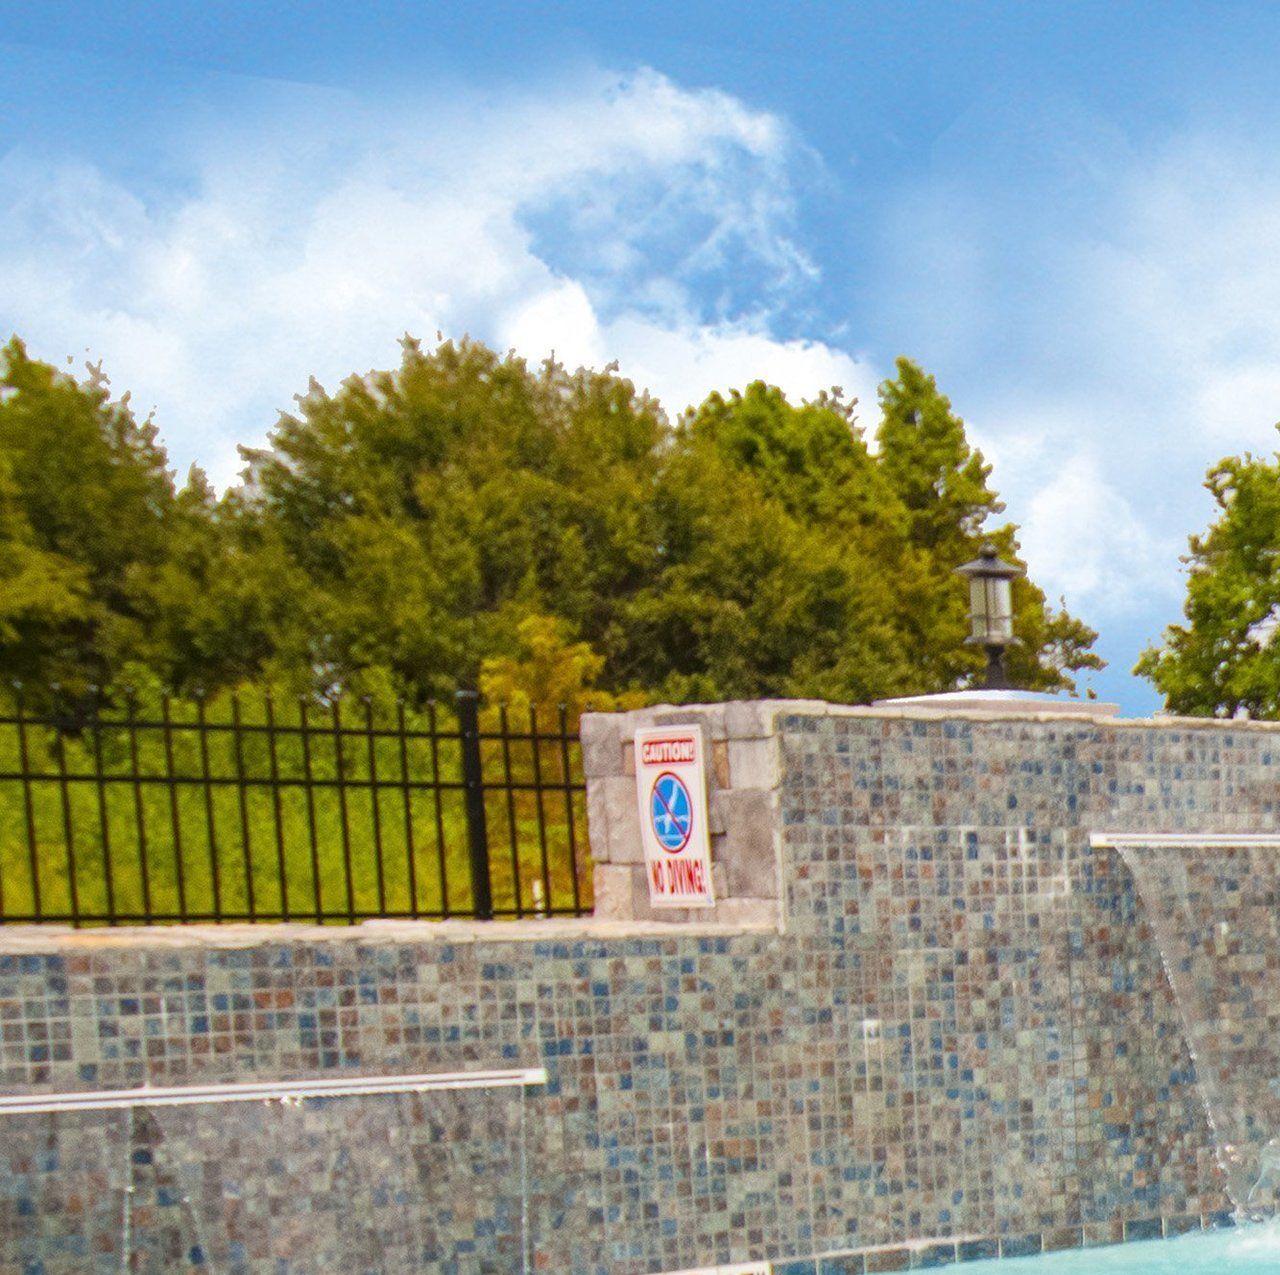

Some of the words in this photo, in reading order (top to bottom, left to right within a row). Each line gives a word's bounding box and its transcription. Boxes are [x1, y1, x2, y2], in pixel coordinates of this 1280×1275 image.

[642, 742, 694, 763] CAUTION!
[652, 860, 664, 894] NO
[668, 859, 706, 895] DIVING!
